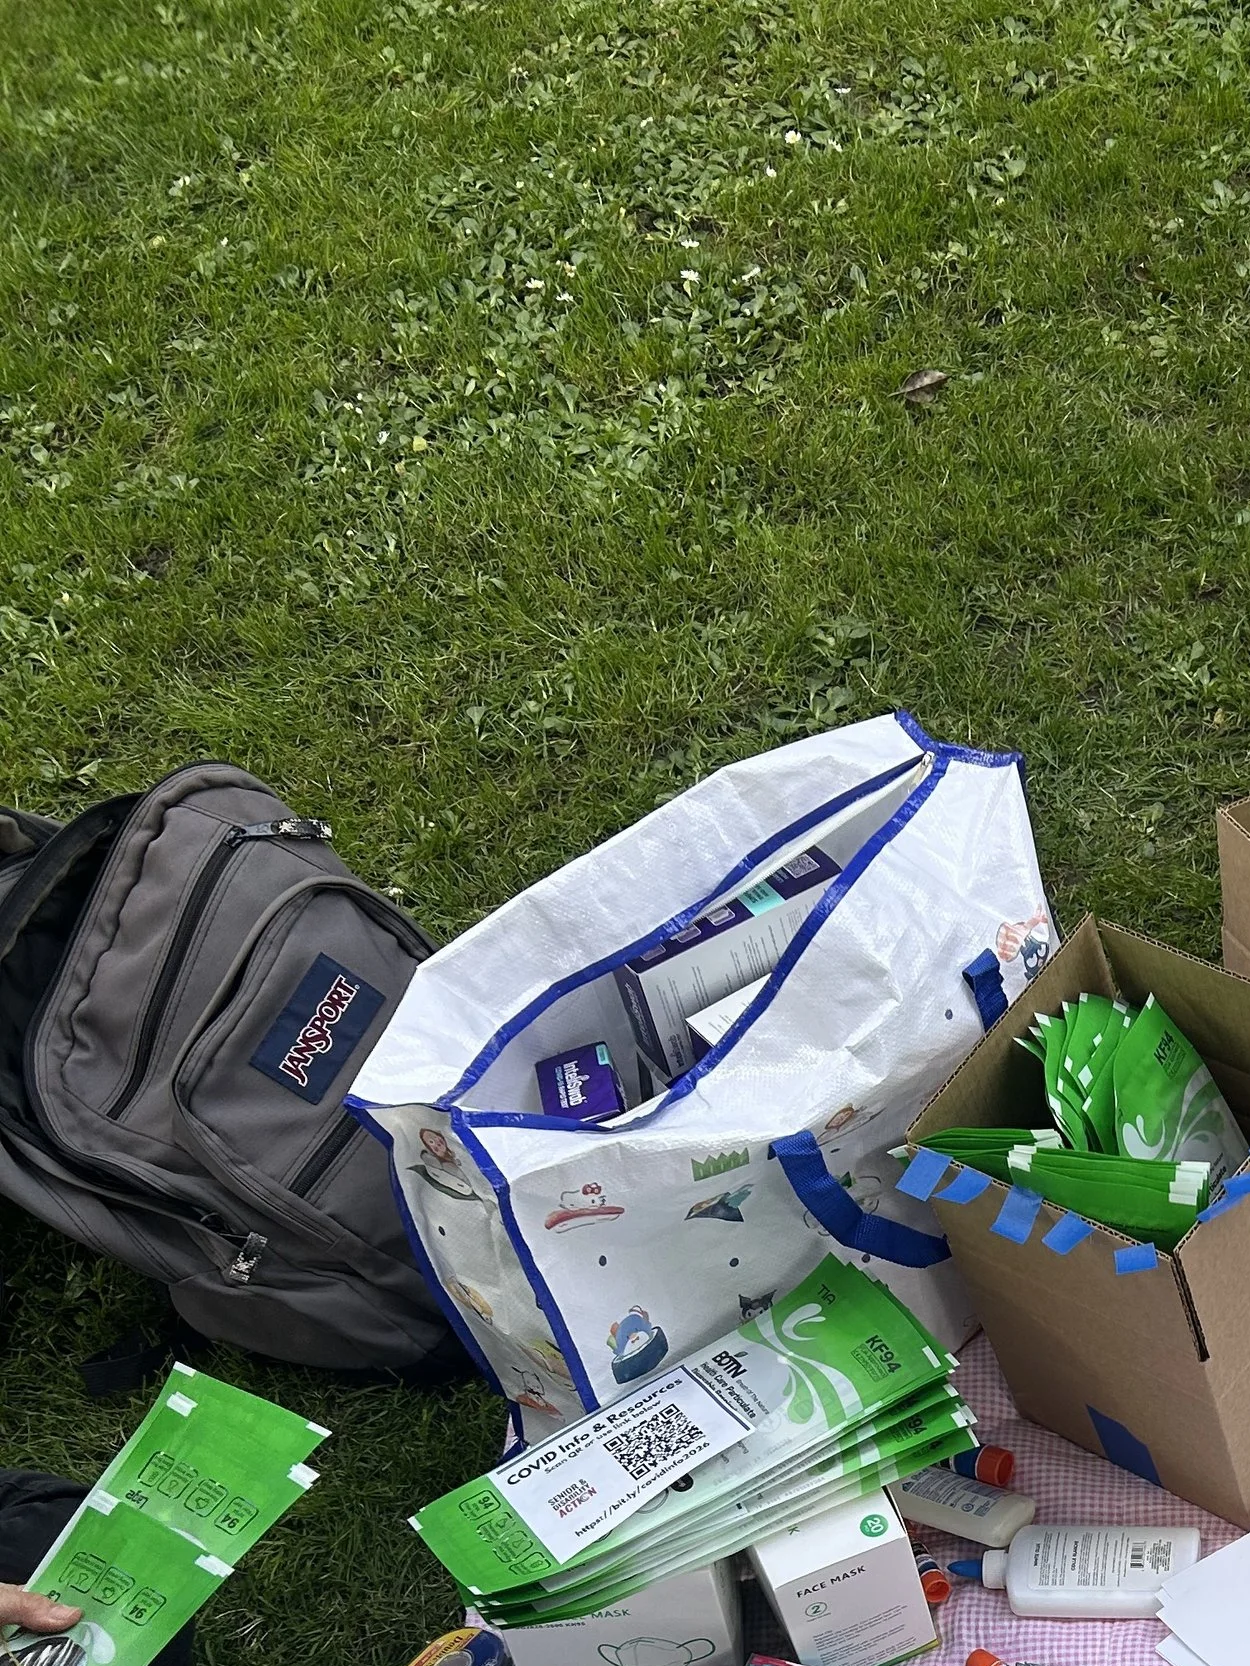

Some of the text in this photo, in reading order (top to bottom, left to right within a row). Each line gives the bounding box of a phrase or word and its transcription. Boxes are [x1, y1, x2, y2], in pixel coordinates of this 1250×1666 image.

[279, 974, 358, 1087] JANSPORT
[1154, 1030, 1174, 1066] KF94
[712, 1351, 748, 1378] BOTN
[865, 1334, 901, 1374] KF94
[507, 1451, 558, 1486] COVID
[561, 1431, 590, 1455] Info
[592, 1421, 607, 1433] &
[606, 1378, 683, 1423] Resources
[547, 1485, 578, 1506] SENIOR
[866, 1517, 884, 1533] 20
[796, 1565, 866, 1598] FACE MASK
[591, 1609, 631, 1620] MASK
[812, 1605, 821, 1614] 2
